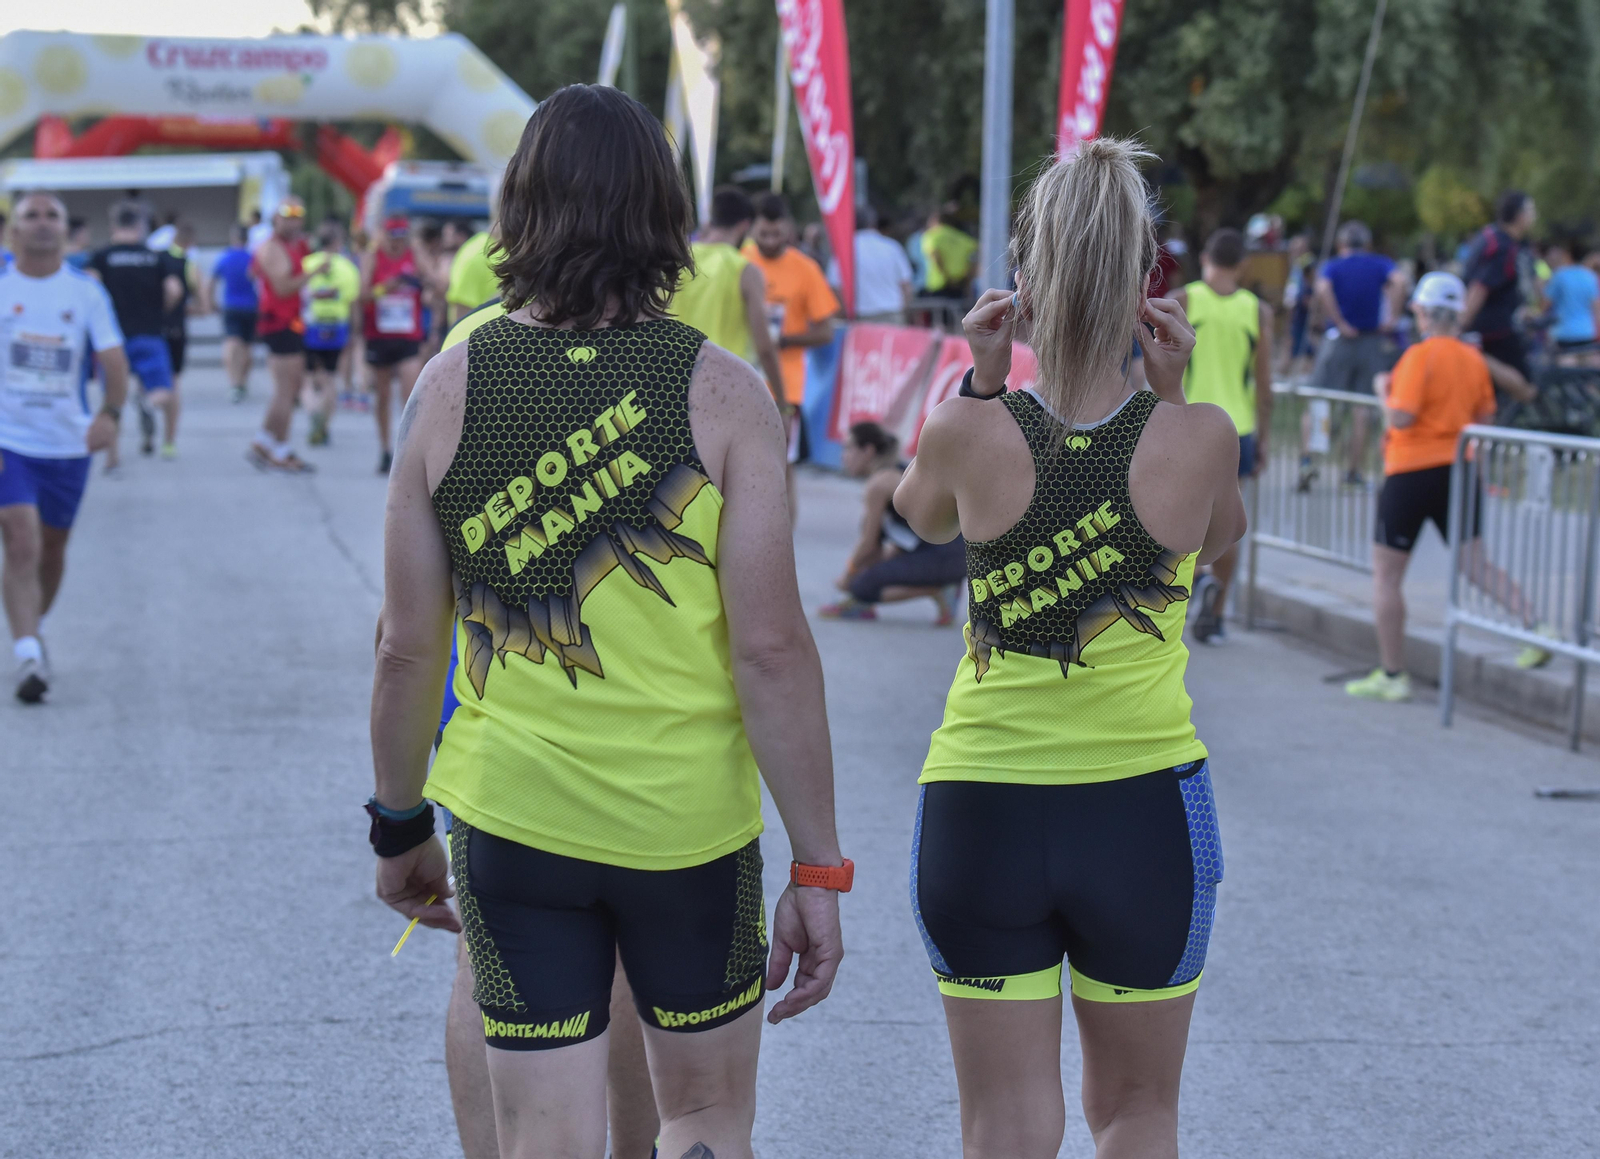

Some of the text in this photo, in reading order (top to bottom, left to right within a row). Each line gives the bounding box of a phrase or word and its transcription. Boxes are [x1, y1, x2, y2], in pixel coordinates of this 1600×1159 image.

[461, 389, 648, 554] DEPORTE
[503, 449, 652, 576] MANIA
[971, 499, 1122, 603] DEPORTE
[999, 545, 1126, 628] MANIA
[652, 975, 762, 1028] DEPORTEMANIA
